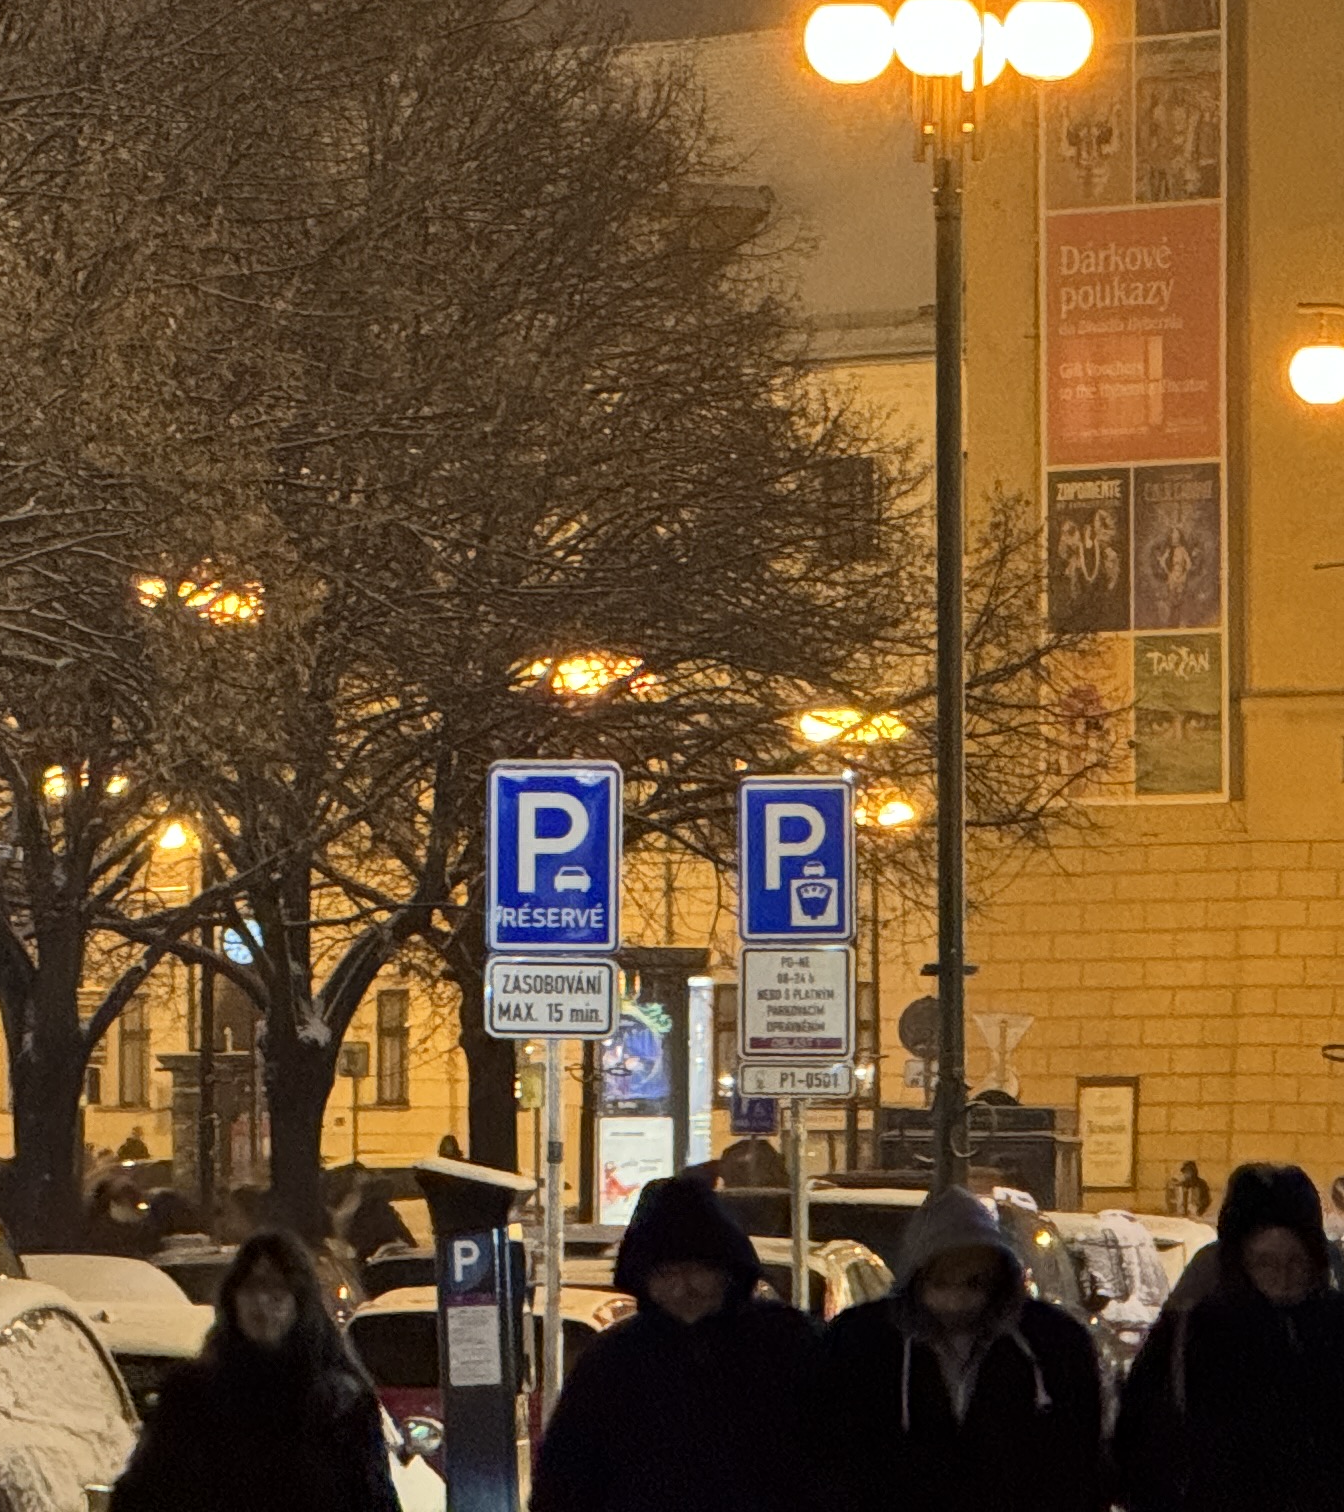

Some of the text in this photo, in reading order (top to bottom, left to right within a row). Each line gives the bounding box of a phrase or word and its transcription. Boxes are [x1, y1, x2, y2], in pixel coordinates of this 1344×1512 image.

[1059, 237, 1173, 275] Dárkové
[1059, 276, 1175, 319] poukazy
[1146, 644, 1211, 680] TARZAN
[518, 791, 591, 893] P
[764, 803, 827, 891] P
[502, 902, 605, 928] RÉSERVÉ
[498, 1002, 604, 1023] MAX. 15 min.
[780, 1072, 839, 1088] P1-0501
[453, 1239, 482, 1283] P
